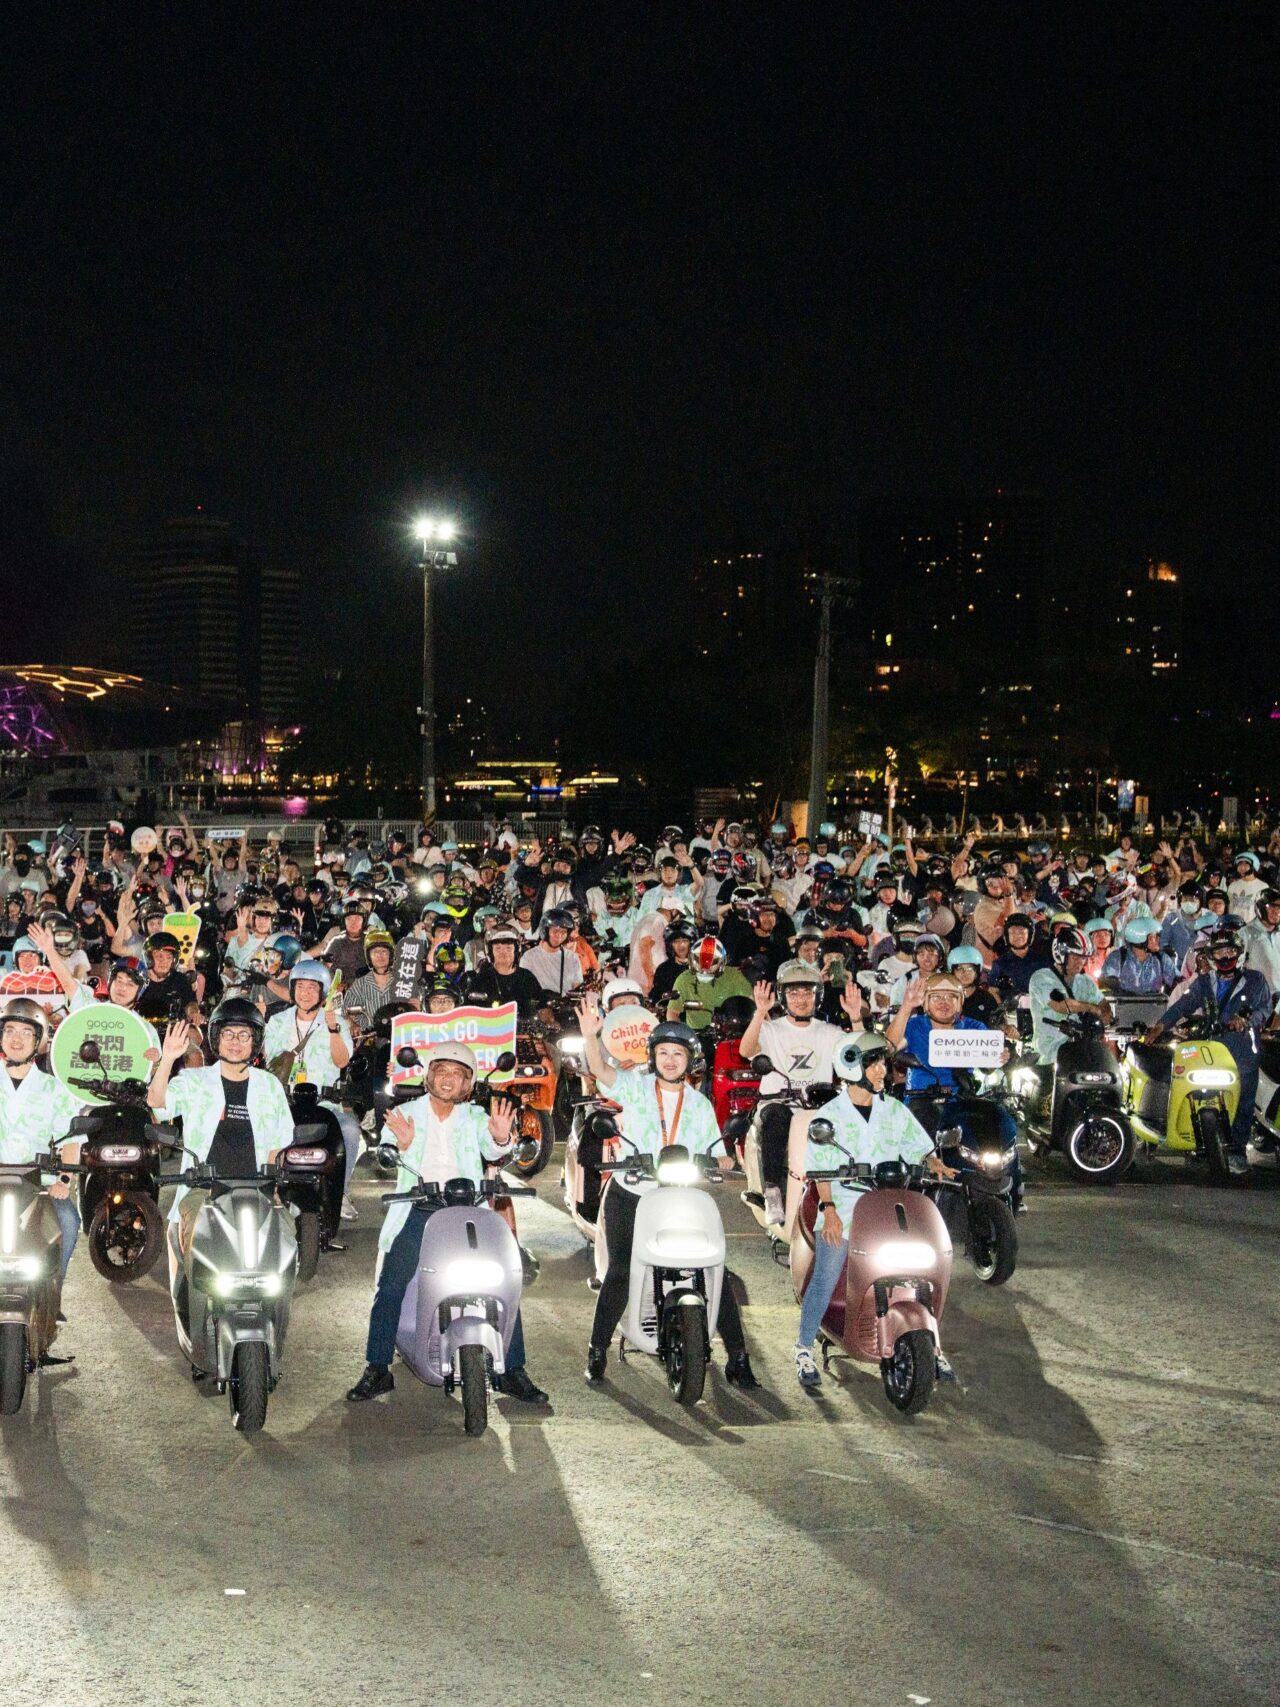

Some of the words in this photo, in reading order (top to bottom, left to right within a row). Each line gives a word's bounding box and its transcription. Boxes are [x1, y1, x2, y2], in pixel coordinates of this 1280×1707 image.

[395, 942, 419, 998] 就在這
[87, 1020, 125, 1031] gogoro
[400, 1023, 450, 1047] LET'S
[454, 1020, 478, 1042] GO
[623, 1037, 646, 1051] PGO
